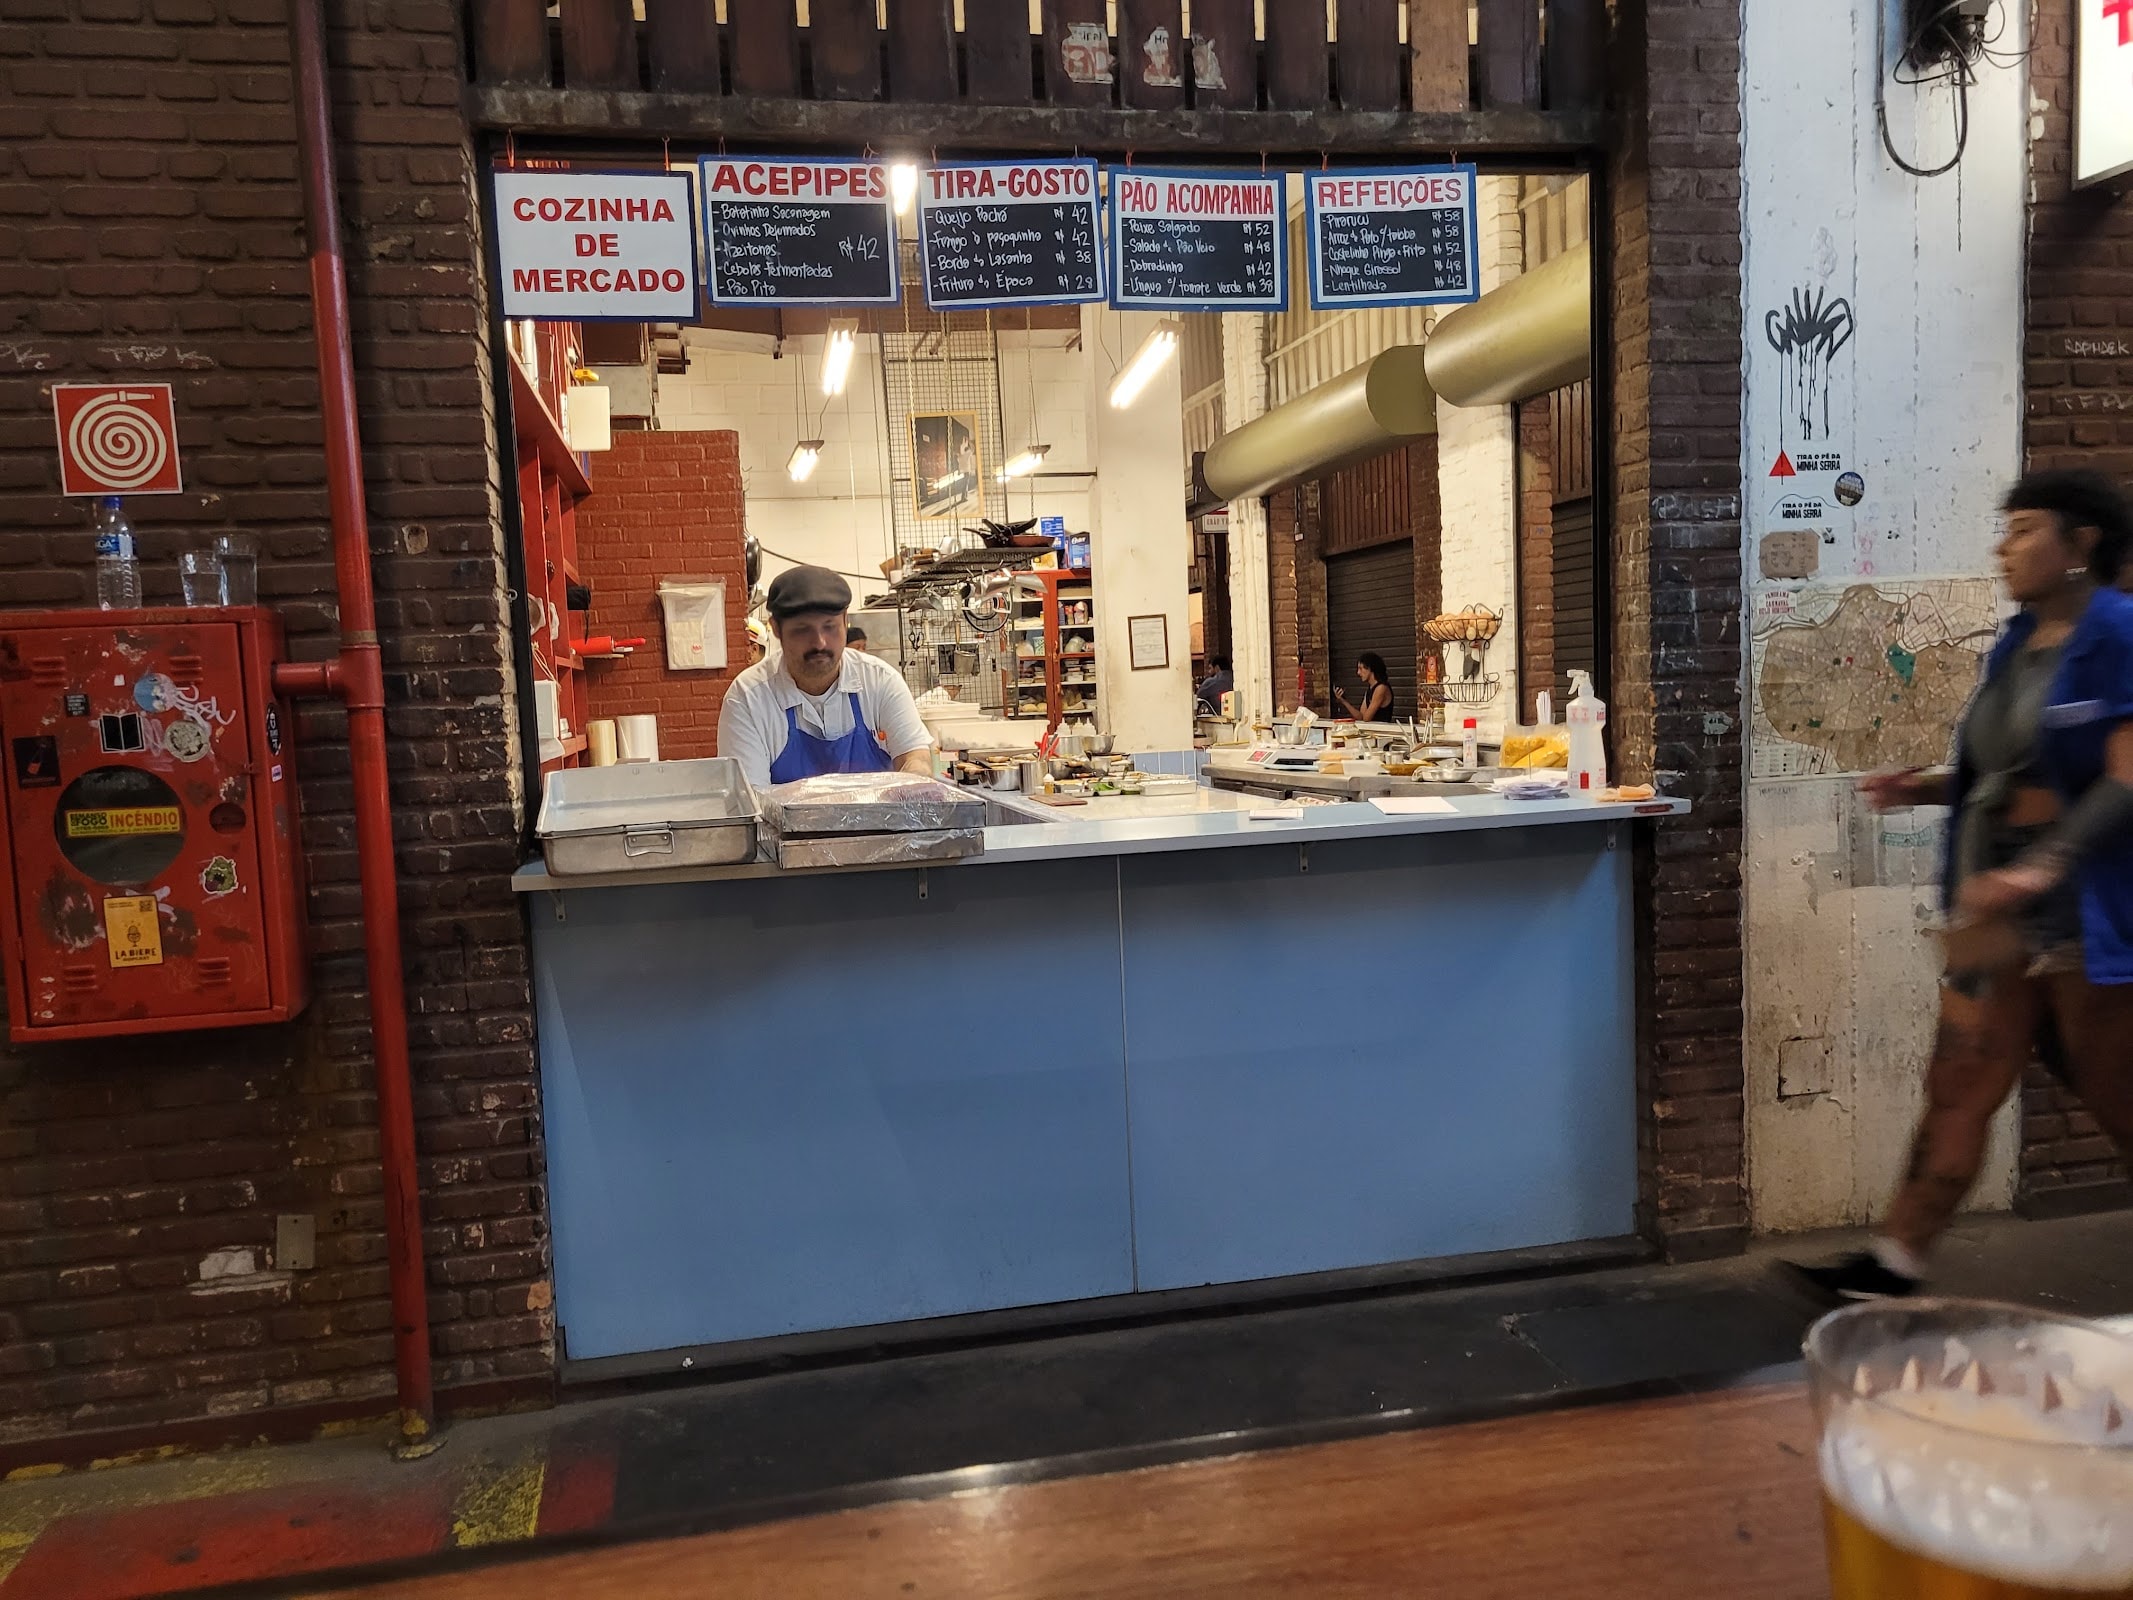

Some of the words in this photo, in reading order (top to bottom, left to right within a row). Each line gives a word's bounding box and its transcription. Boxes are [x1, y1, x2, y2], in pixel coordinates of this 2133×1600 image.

[711, 164, 887, 199] ACEPIPES
[926, 168, 1090, 199] TIRA-GOSTO
[1318, 176, 1462, 208] REFEIÇÕES
[1121, 177, 1158, 212] PÃO
[1166, 183, 1274, 215] ACOMPANHA
[513, 198, 675, 222] COZINHA
[721, 203, 769, 219] Batatinha
[772, 205, 831, 222] Sacanagem
[935, 209, 972, 229] Queijo
[975, 206, 1008, 223] Pachá
[1053, 206, 1064, 221] R$
[1072, 205, 1088, 225] 42
[1327, 214, 1370, 229] Pirarucu
[1431, 212, 1441, 222] R$
[1444, 210, 1461, 221] 58
[722, 223, 762, 237] Ovinhos
[763, 223, 816, 241] Defumados
[1129, 219, 1155, 235] Peixe
[1158, 220, 1201, 238] Salgado
[1255, 223, 1271, 236] 52
[1328, 231, 1349, 246] Arroz
[1445, 225, 1460, 238] 58
[575, 233, 620, 257] DE
[722, 240, 777, 257] Azeitonas
[838, 236, 854, 262] R$
[856, 234, 880, 261] 42
[933, 230, 968, 253] Frango
[987, 229, 1042, 250] paçoquinha
[1054, 229, 1065, 244] R$
[1072, 228, 1091, 247] 42
[1129, 238, 1161, 253] Salada
[1175, 239, 1194, 254] Pão
[1257, 240, 1271, 254] 48
[937, 254, 970, 271] Borda
[988, 250, 1033, 267] Lasanha
[1055, 250, 1065, 265] R$
[1075, 250, 1092, 264] 38
[1328, 245, 1369, 262] Costelinha
[1372, 245, 1396, 263] Pinga
[1402, 244, 1426, 258] Frita
[1445, 242, 1462, 256] 52
[723, 261, 762, 276] Cebolas
[1129, 259, 1184, 275] Dobradinha
[1257, 260, 1272, 275] 42
[1329, 263, 1361, 280] Nhoque
[1364, 262, 1402, 276] Girassol
[1446, 258, 1462, 273] 48
[512, 268, 686, 293] MERCADO
[726, 278, 749, 295] Pão
[751, 279, 776, 296] Pita
[938, 275, 974, 293] Fritura
[996, 270, 1034, 292] Época
[1057, 274, 1069, 291] R$
[1075, 275, 1093, 289] 28
[1130, 277, 1162, 296] Língua
[1178, 279, 1211, 296] tomate
[1258, 278, 1274, 293] 38
[1331, 279, 1387, 292] Lentilhada
[1447, 275, 1464, 288] 42
[1796, 461, 1818, 471] MINHA
[1820, 460, 1841, 471] SERRA
[1782, 509, 1801, 519] MINHA
[1803, 509, 1822, 518] SERRA
[109, 810, 178, 829] INCÊNDIO
